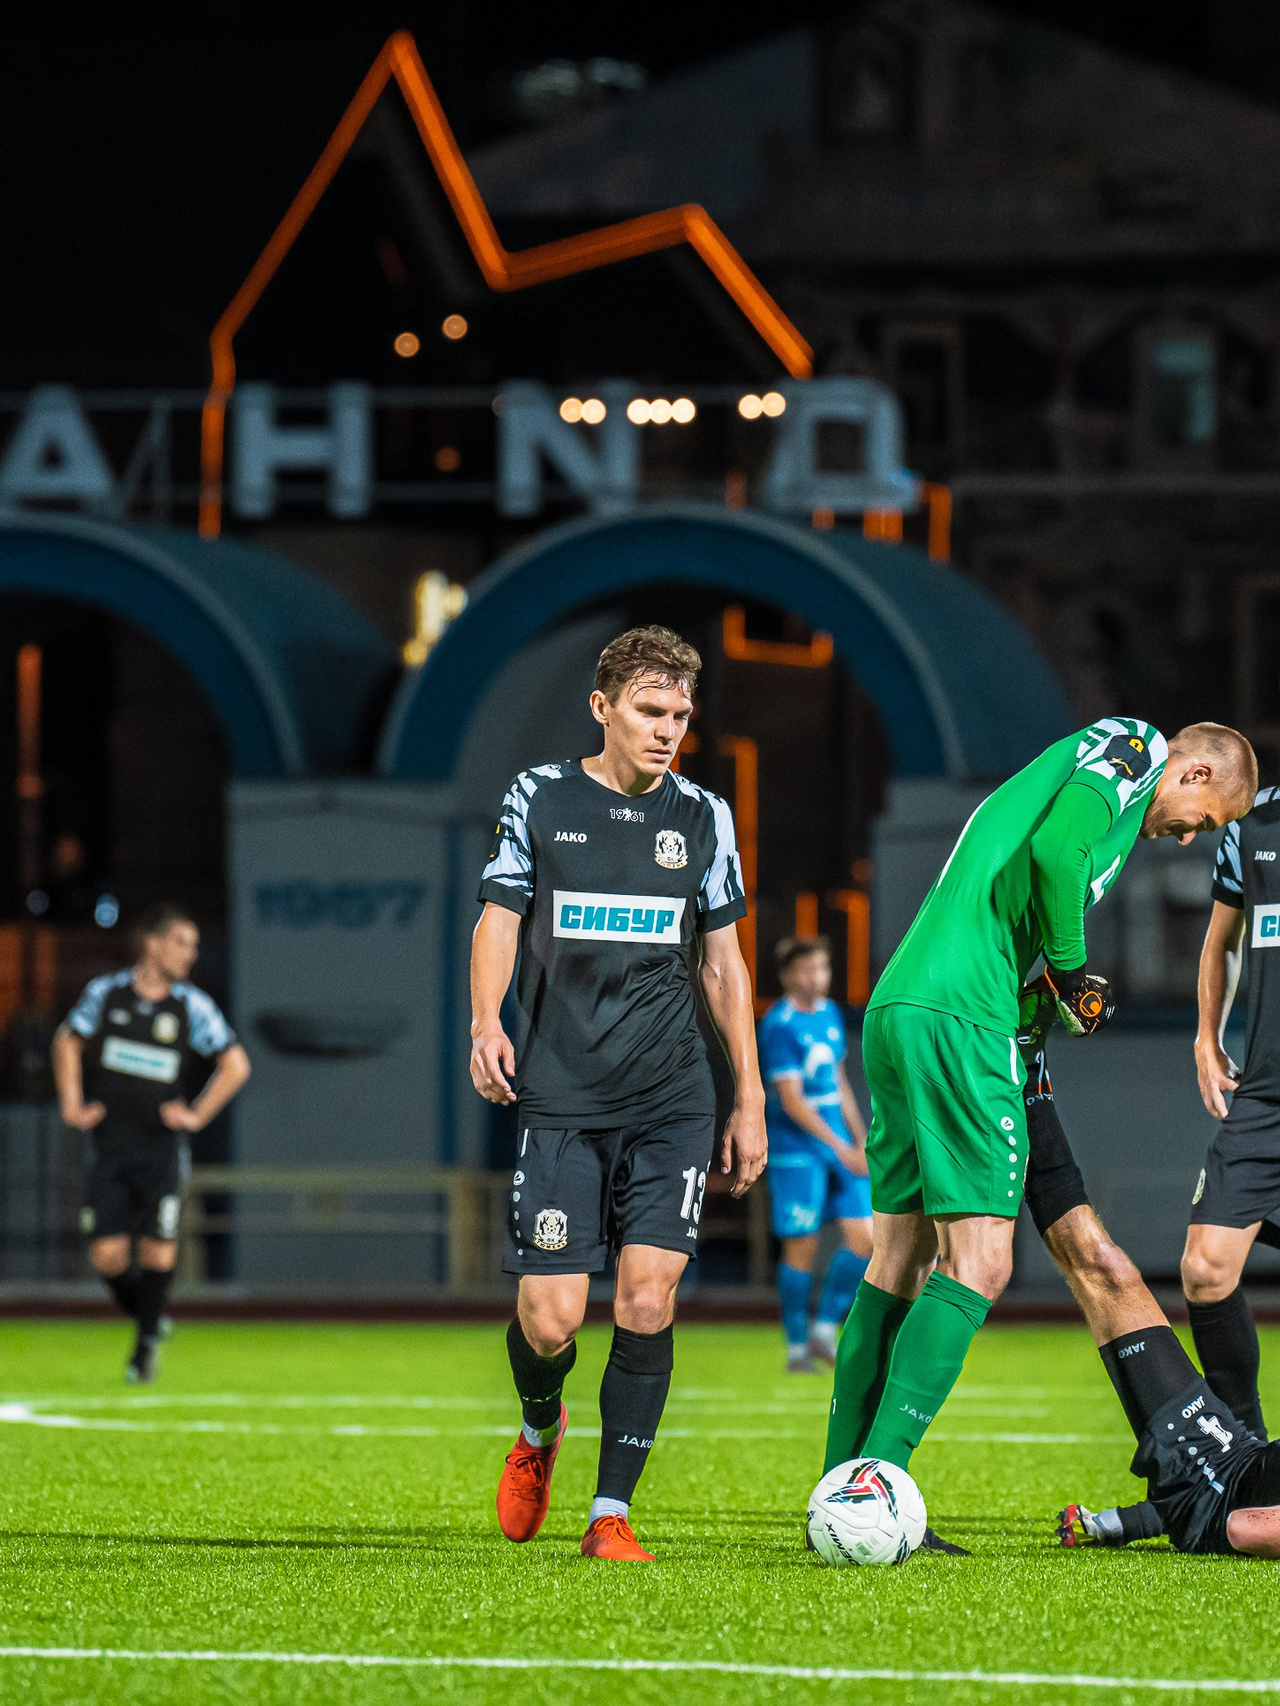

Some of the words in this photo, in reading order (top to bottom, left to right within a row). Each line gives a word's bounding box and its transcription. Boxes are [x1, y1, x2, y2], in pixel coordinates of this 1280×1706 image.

[554, 831, 587, 843] JAKO
[1254, 851, 1276, 861] JAKO
[560, 904, 675, 934] СИБУР
[1118, 1341, 1146, 1359] JAKO
[899, 1404, 933, 1424] JAKO
[1181, 1395, 1206, 1419] JAKO
[617, 1434, 654, 1449] JAKO
[825, 1522, 861, 1567] DEMIX
